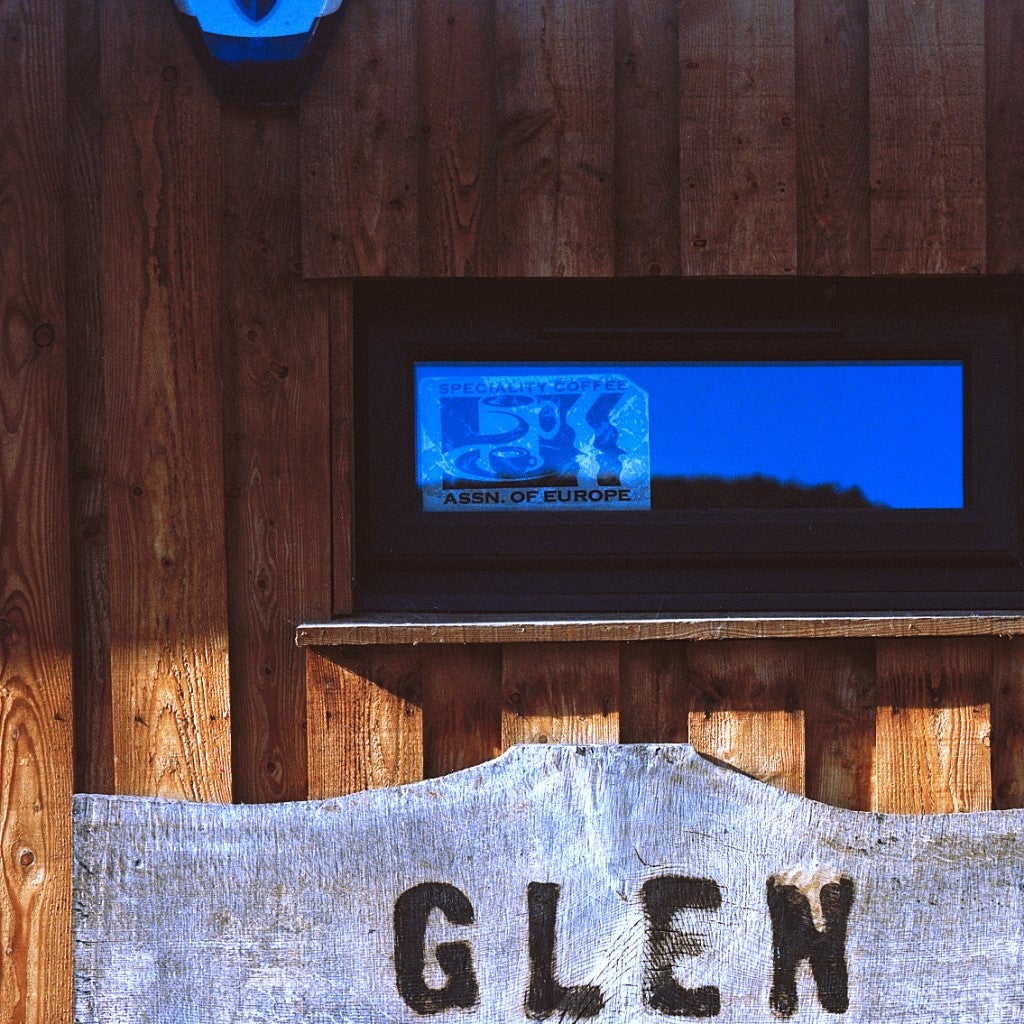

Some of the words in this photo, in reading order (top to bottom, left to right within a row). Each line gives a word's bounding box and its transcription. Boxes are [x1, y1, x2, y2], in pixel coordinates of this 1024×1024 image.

[438, 380, 547, 395] SPECIALITY
[553, 379, 628, 393] COFFEE
[443, 490, 505, 505] ASSN.
[510, 490, 539, 503] OF
[544, 489, 632, 503] EUROPE
[393, 875, 855, 1018] GLEN
